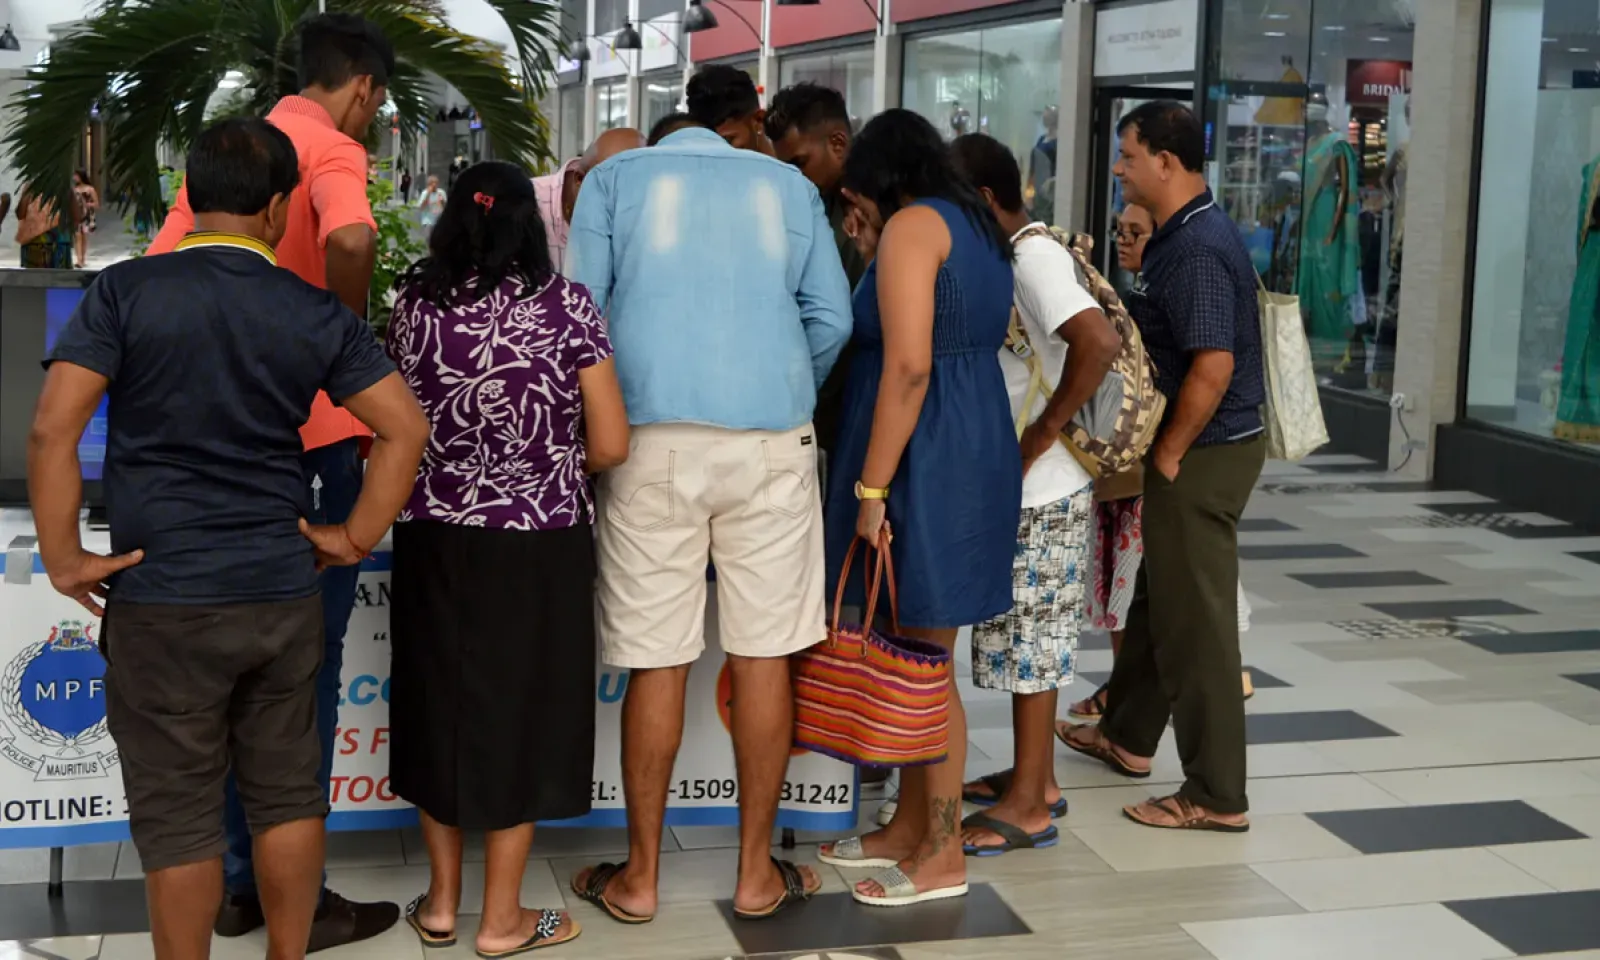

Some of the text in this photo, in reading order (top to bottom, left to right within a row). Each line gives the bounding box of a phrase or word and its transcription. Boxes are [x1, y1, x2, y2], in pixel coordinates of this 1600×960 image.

[2, 744, 36, 769] POLICE
[46, 762, 98, 776] MAURITIUS
[0, 795, 112, 822] OTLINE:
